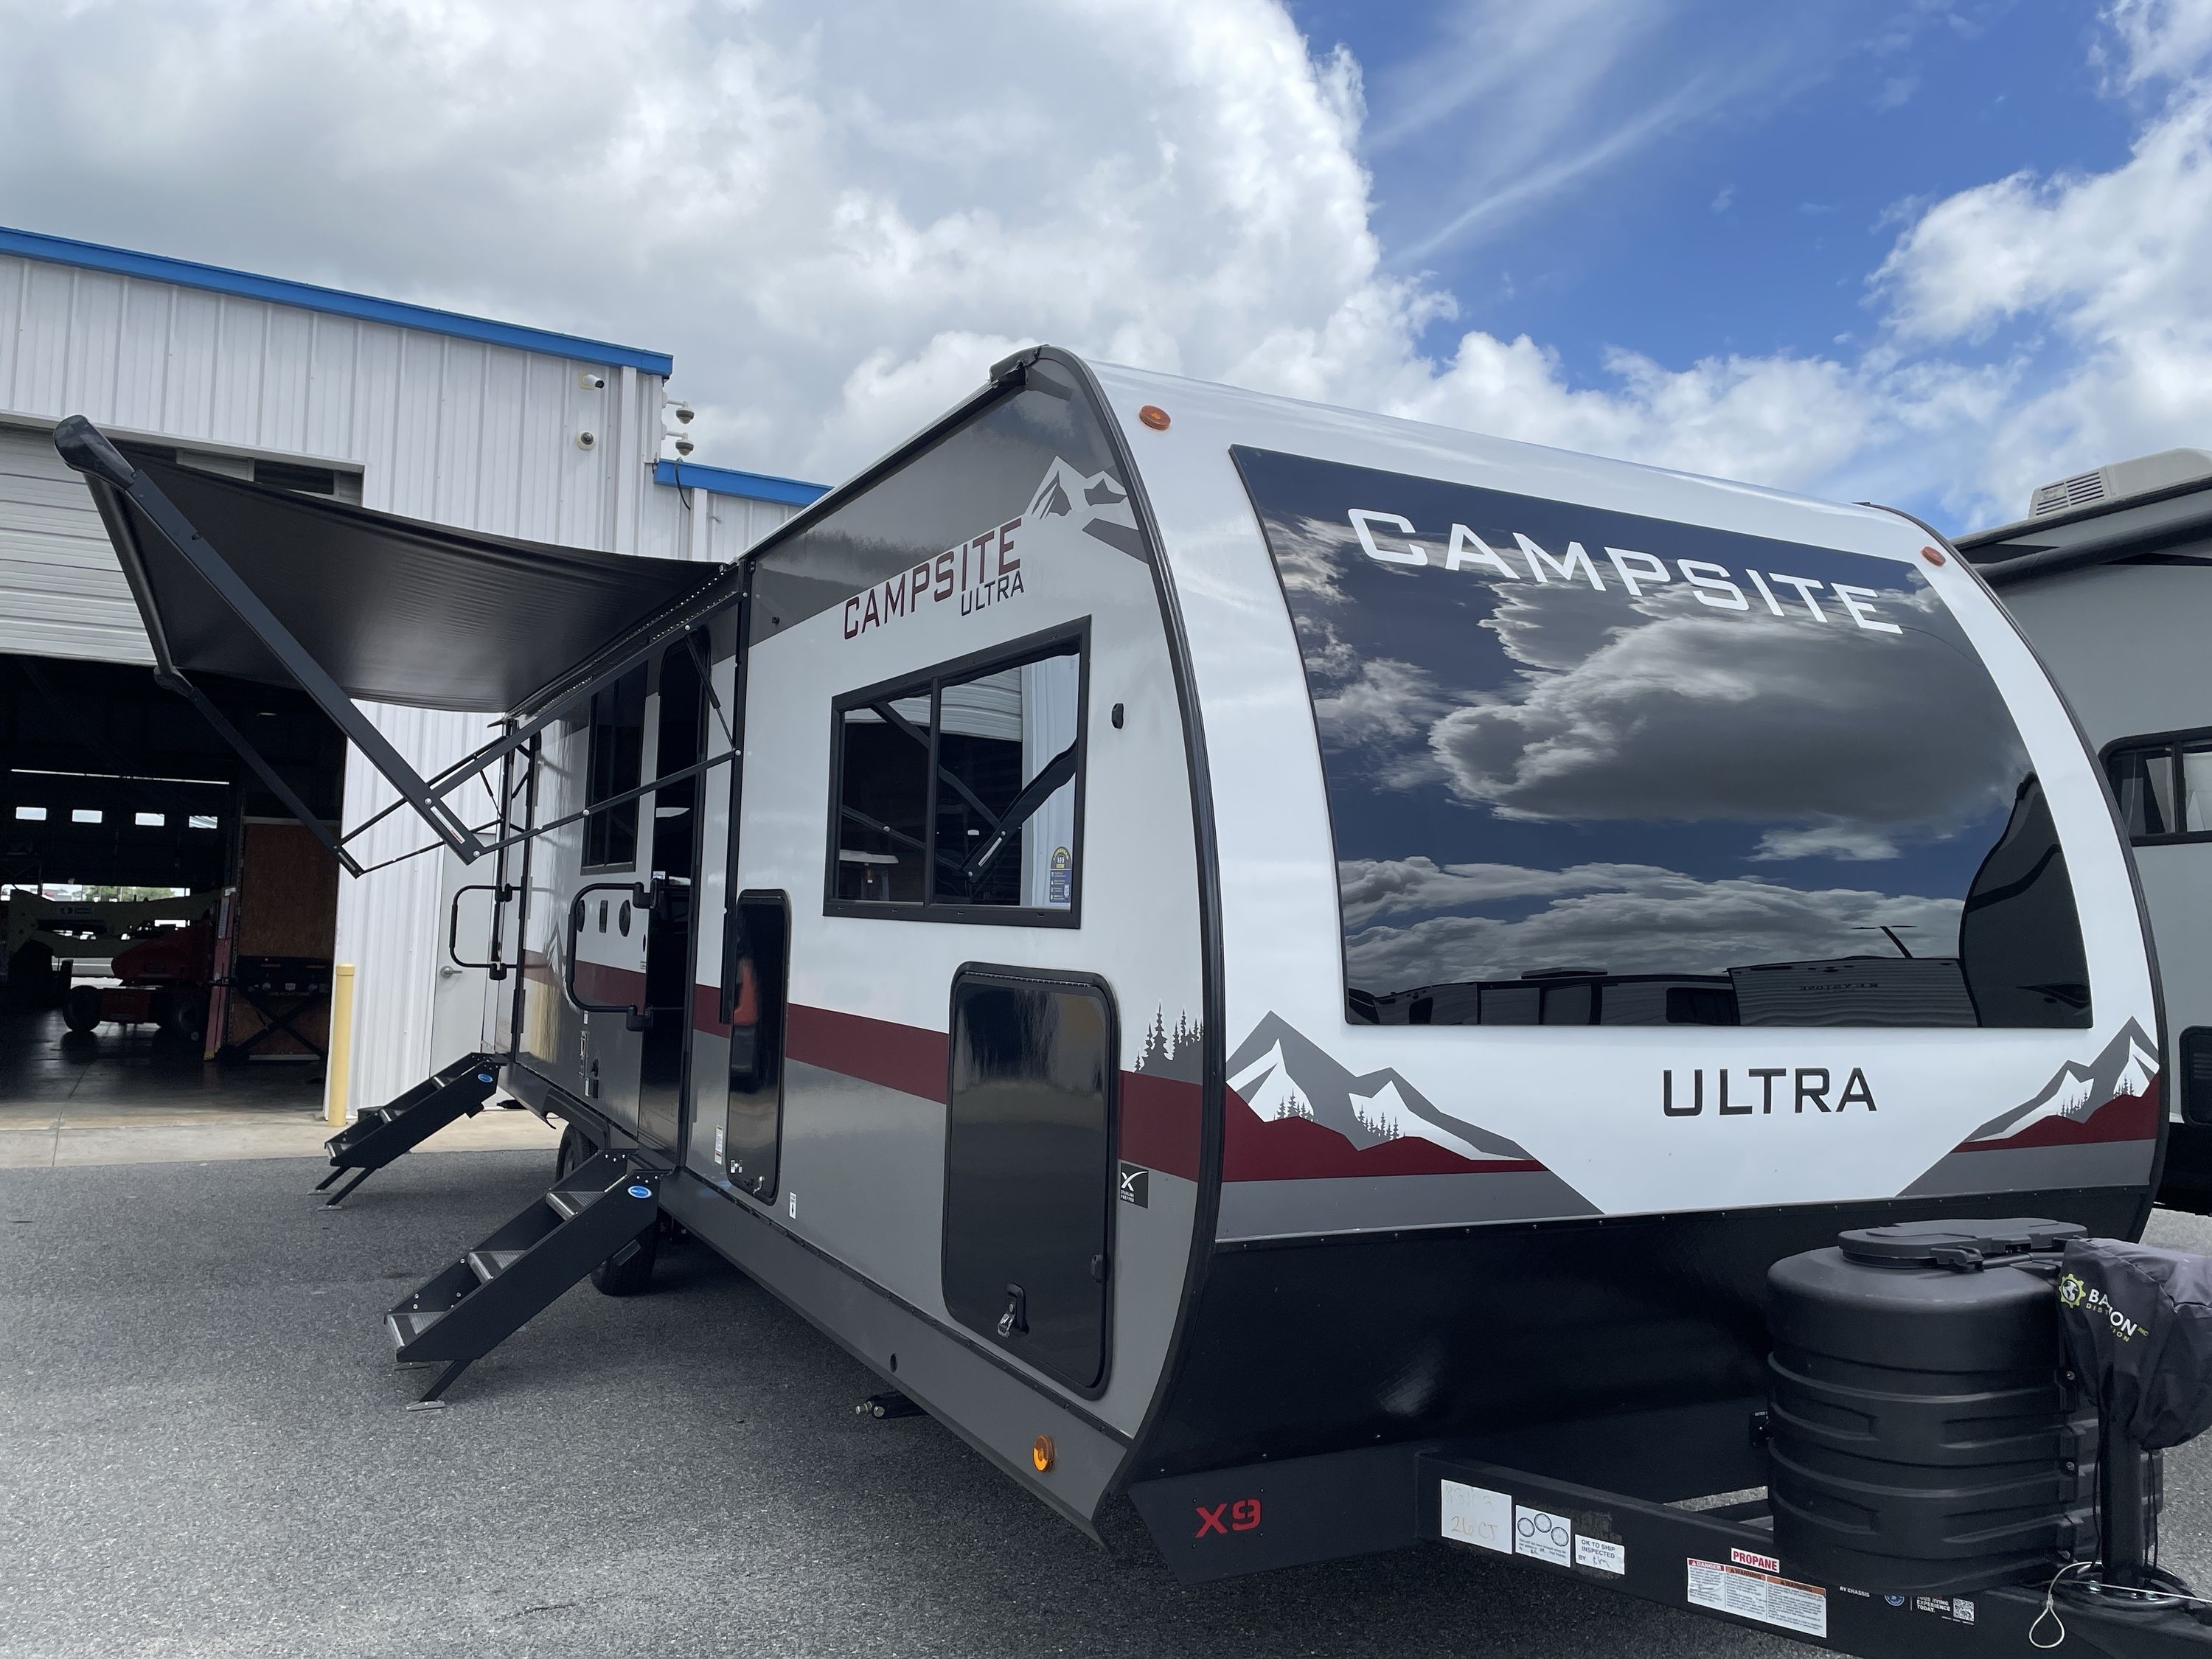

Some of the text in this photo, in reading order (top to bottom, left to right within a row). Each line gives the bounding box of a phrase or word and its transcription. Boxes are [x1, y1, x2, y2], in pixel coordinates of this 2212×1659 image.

[844, 517, 1022, 640] CAMPSITE
[1347, 507, 1904, 635] CAMPSITE
[961, 569, 1025, 616] ULTRA
[1663, 1067, 1878, 1117] ULTRA
[2087, 1288, 2138, 1336] BAON
[1194, 1498, 1262, 1539] X9
[1581, 1539, 1590, 1547] OK
[1581, 1545, 1615, 1559] INSPECTED
[1697, 1562, 1722, 1571] DANGER
[1733, 1550, 1778, 1571] PROPANE
[1847, 1588, 1870, 1598] CHASSIS
[1916, 1599, 1951, 1612] EXPERIENCE
